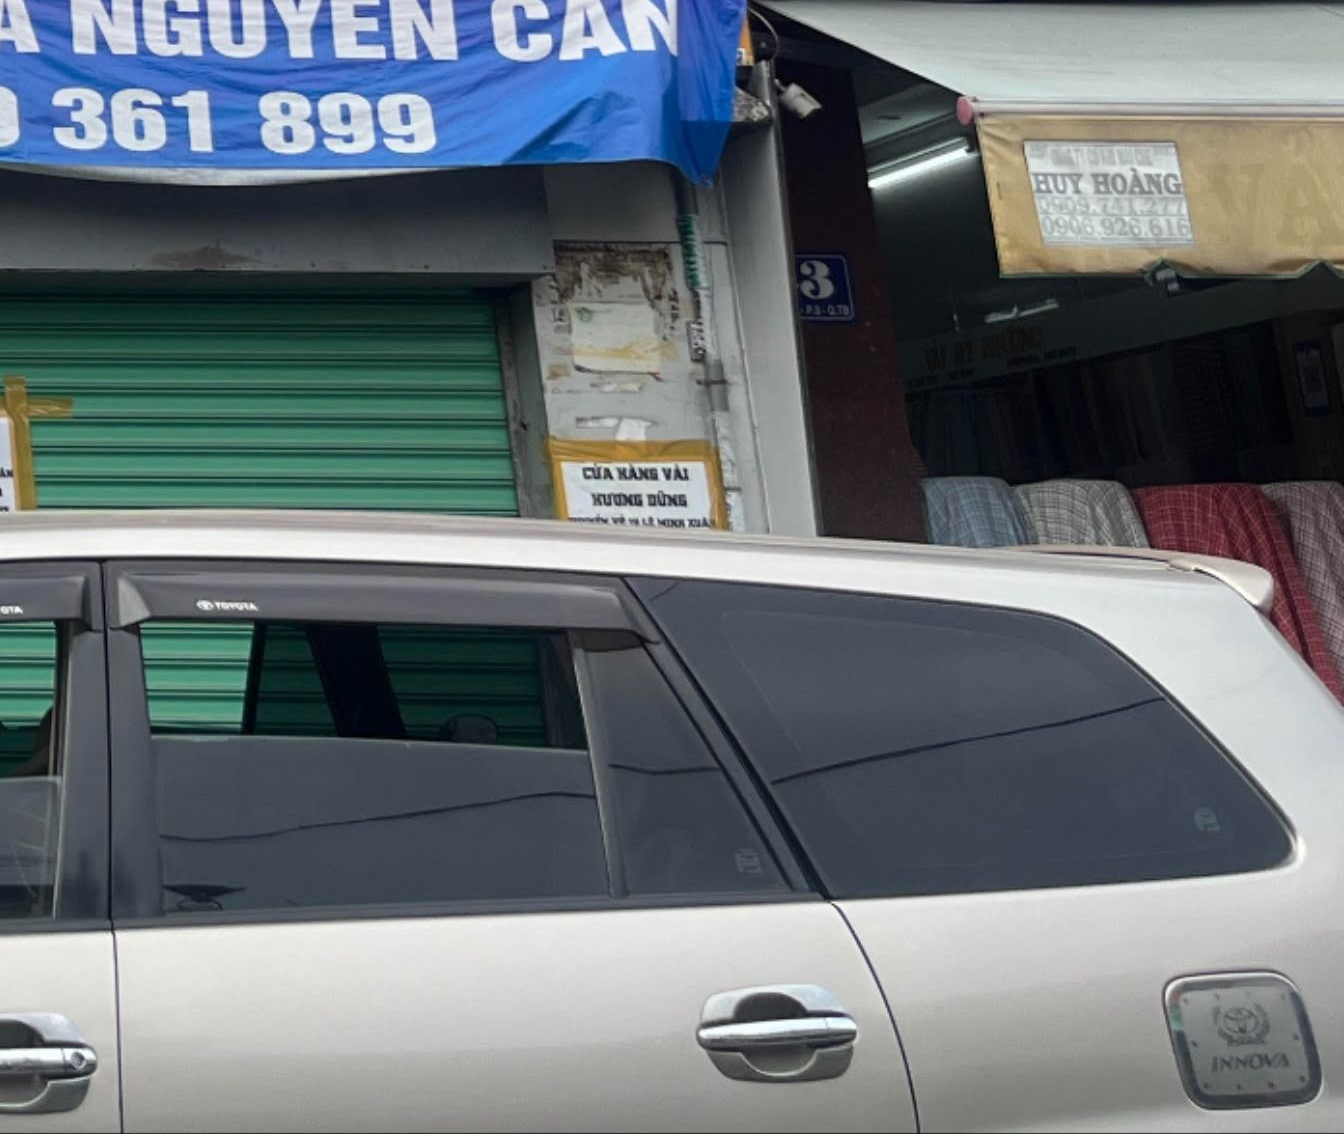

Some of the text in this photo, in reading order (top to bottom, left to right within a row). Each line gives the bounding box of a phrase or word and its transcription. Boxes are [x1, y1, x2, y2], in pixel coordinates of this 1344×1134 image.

[52, 87, 214, 154] 361
[259, 90, 438, 156] 899
[1032, 167, 1183, 196] HUY HOÀNG
